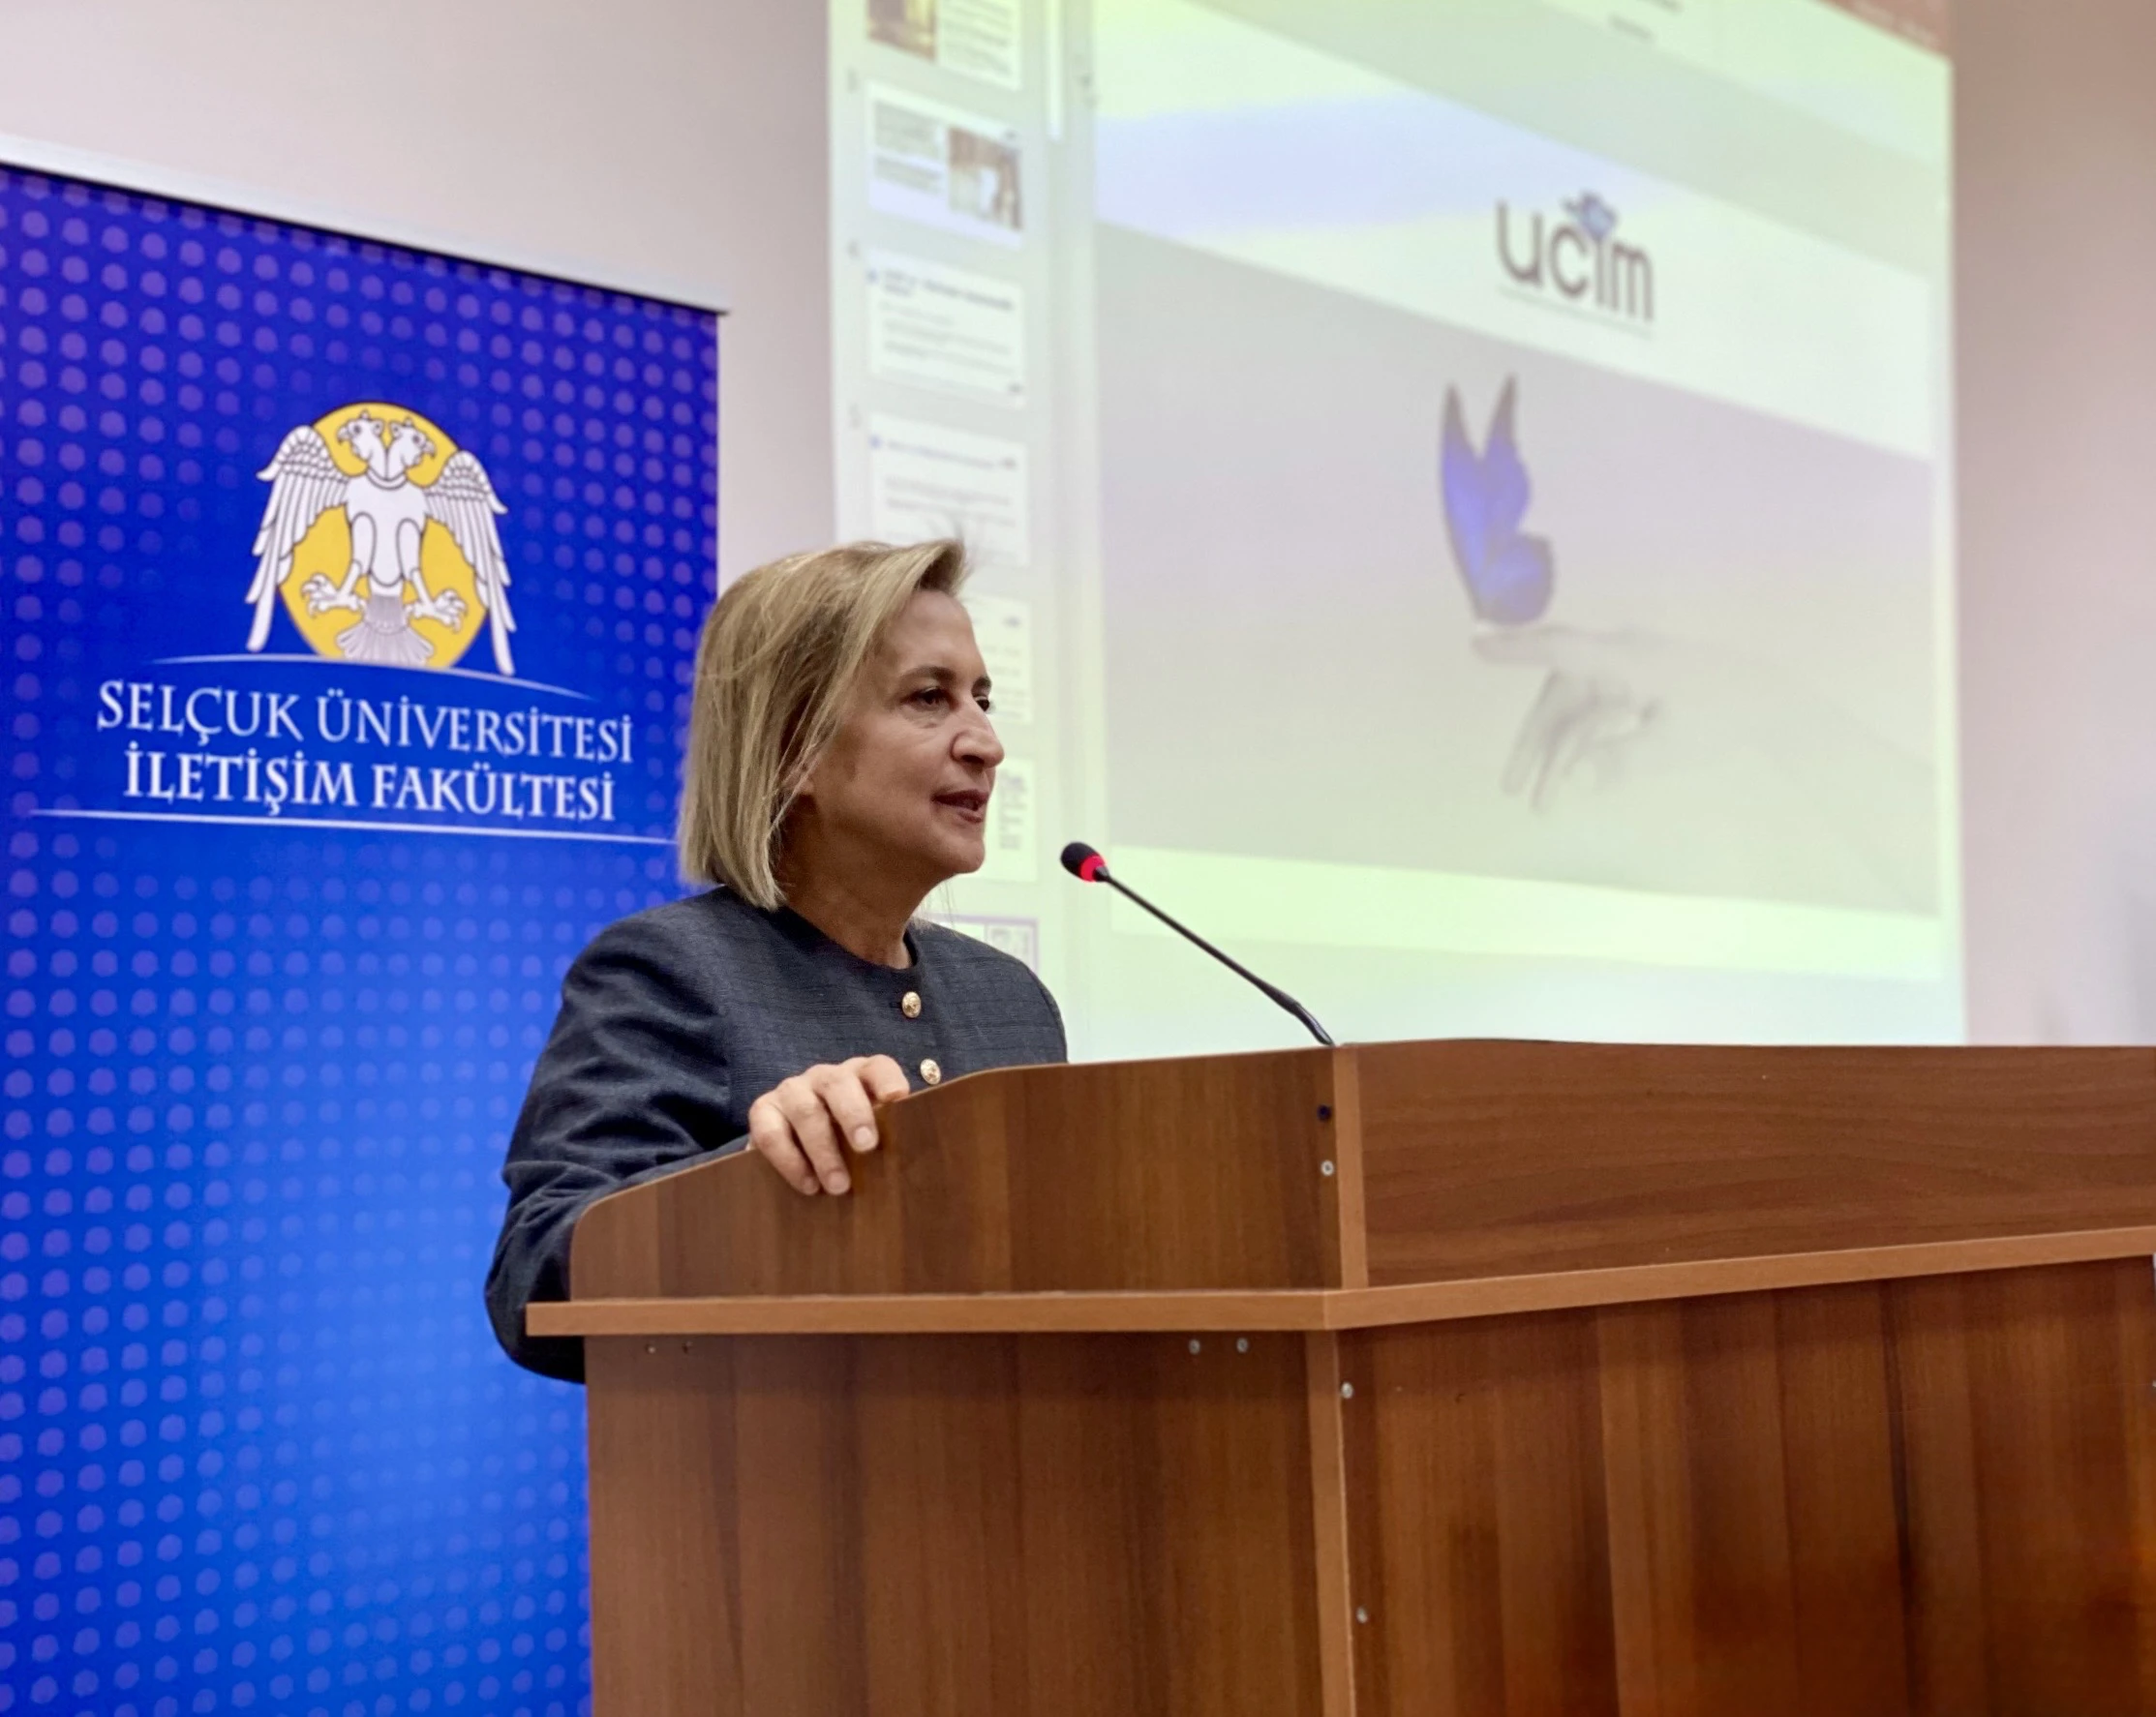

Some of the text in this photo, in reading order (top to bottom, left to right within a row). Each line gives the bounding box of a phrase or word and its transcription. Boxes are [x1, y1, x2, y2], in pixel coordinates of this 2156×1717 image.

[97, 680, 633, 763] SELÇUK ÜNİVERSİTESİ
[124, 741, 616, 822] İLETİŞİM FAKÜLTESİ
